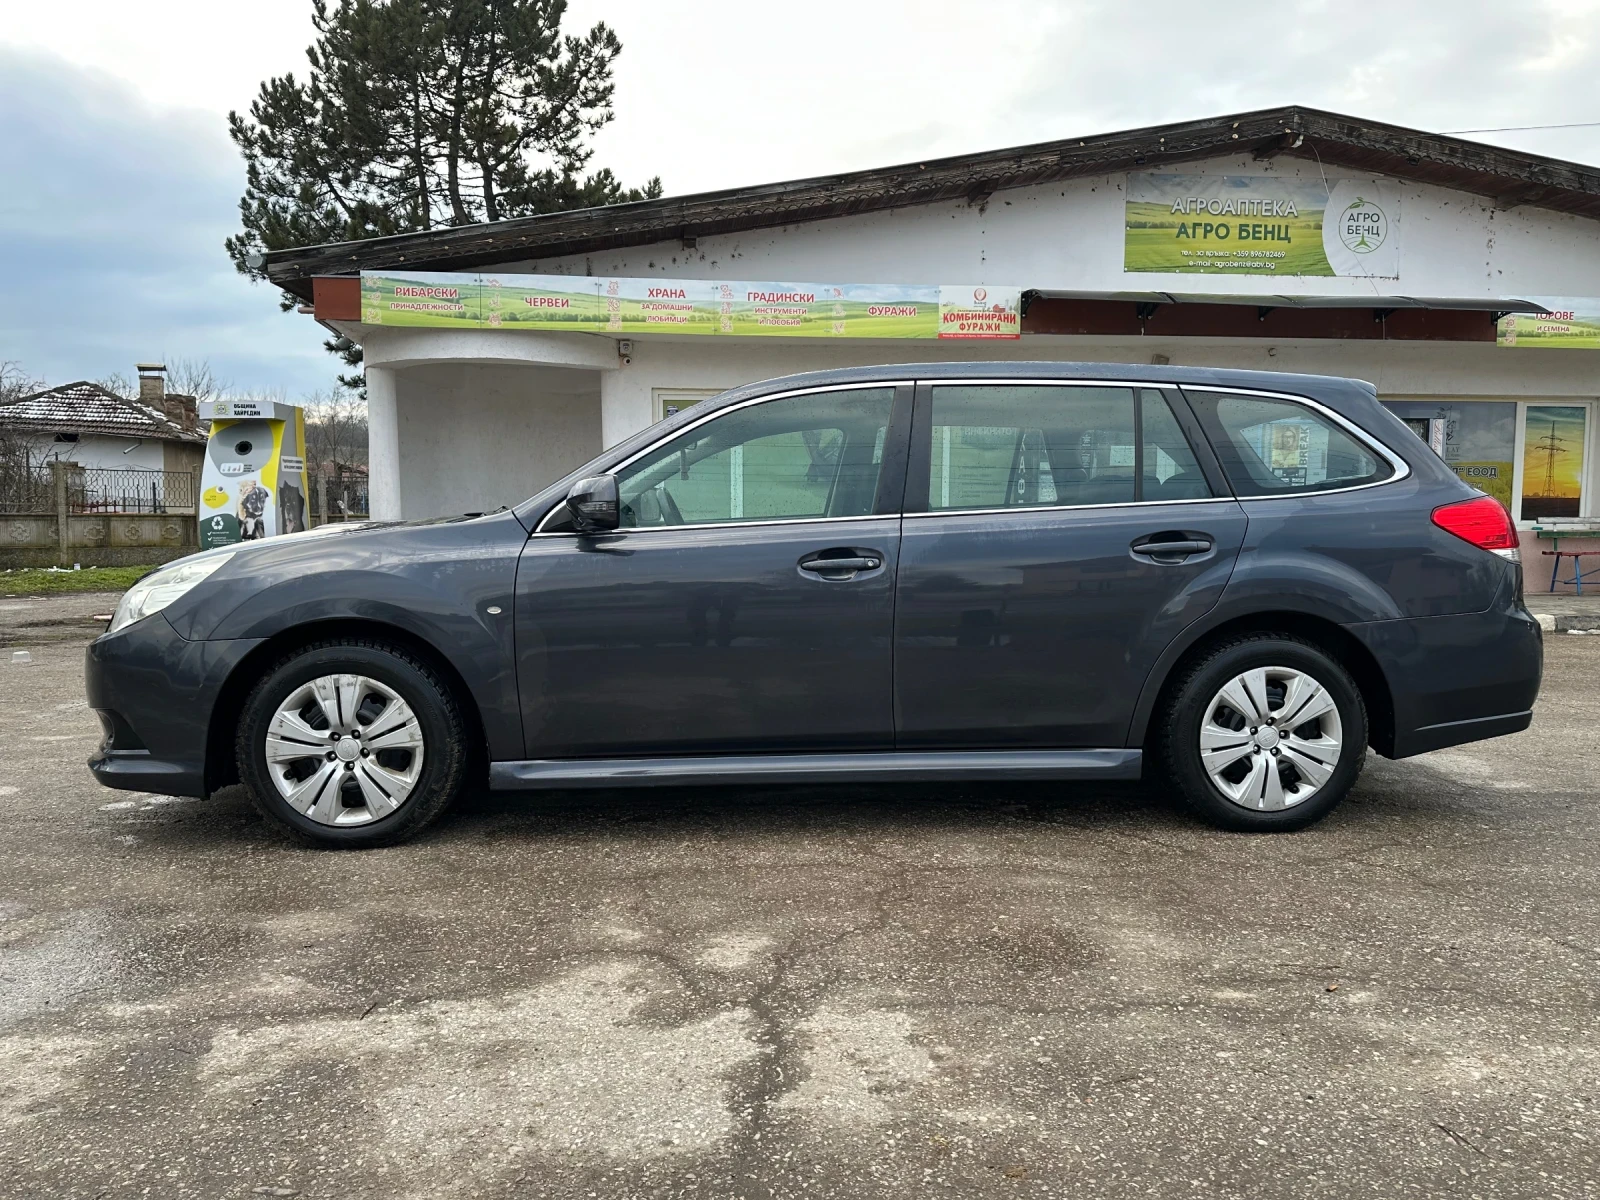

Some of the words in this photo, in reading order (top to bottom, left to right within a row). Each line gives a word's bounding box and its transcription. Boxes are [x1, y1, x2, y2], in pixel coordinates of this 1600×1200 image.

[1170, 197, 1298, 217] АГРОАПТЕКА
[1348, 212, 1380, 223] АГРО
[1175, 222, 1230, 240] АГРО
[1238, 223, 1291, 243] БЕНЦ
[1347, 225, 1380, 237] БЕНЦ
[395, 287, 458, 298] РИБАРСКИ
[648, 288, 686, 299] ХРАНА
[747, 292, 814, 304] ГРАДИНСКИ
[390, 303, 463, 311] ПРИНАДЛЕЖНОСТИ
[524, 297, 570, 308] ЧЕРВЕИ
[651, 303, 693, 311] ДОМАШНИ
[754, 307, 807, 315] ИНСТРУМЕНТИ
[868, 306, 917, 317] ФУРАЖИ
[646, 315, 687, 324] ЛЮБИМЦИ
[766, 318, 800, 326] ПОСОБИЯ
[943, 313, 1016, 325] КОМБИНИРАНИ
[959, 322, 1001, 332] ФУРАЖИ
[1299, 427, 1309, 466] BREAK
[1467, 467, 1497, 478] ЕООД
